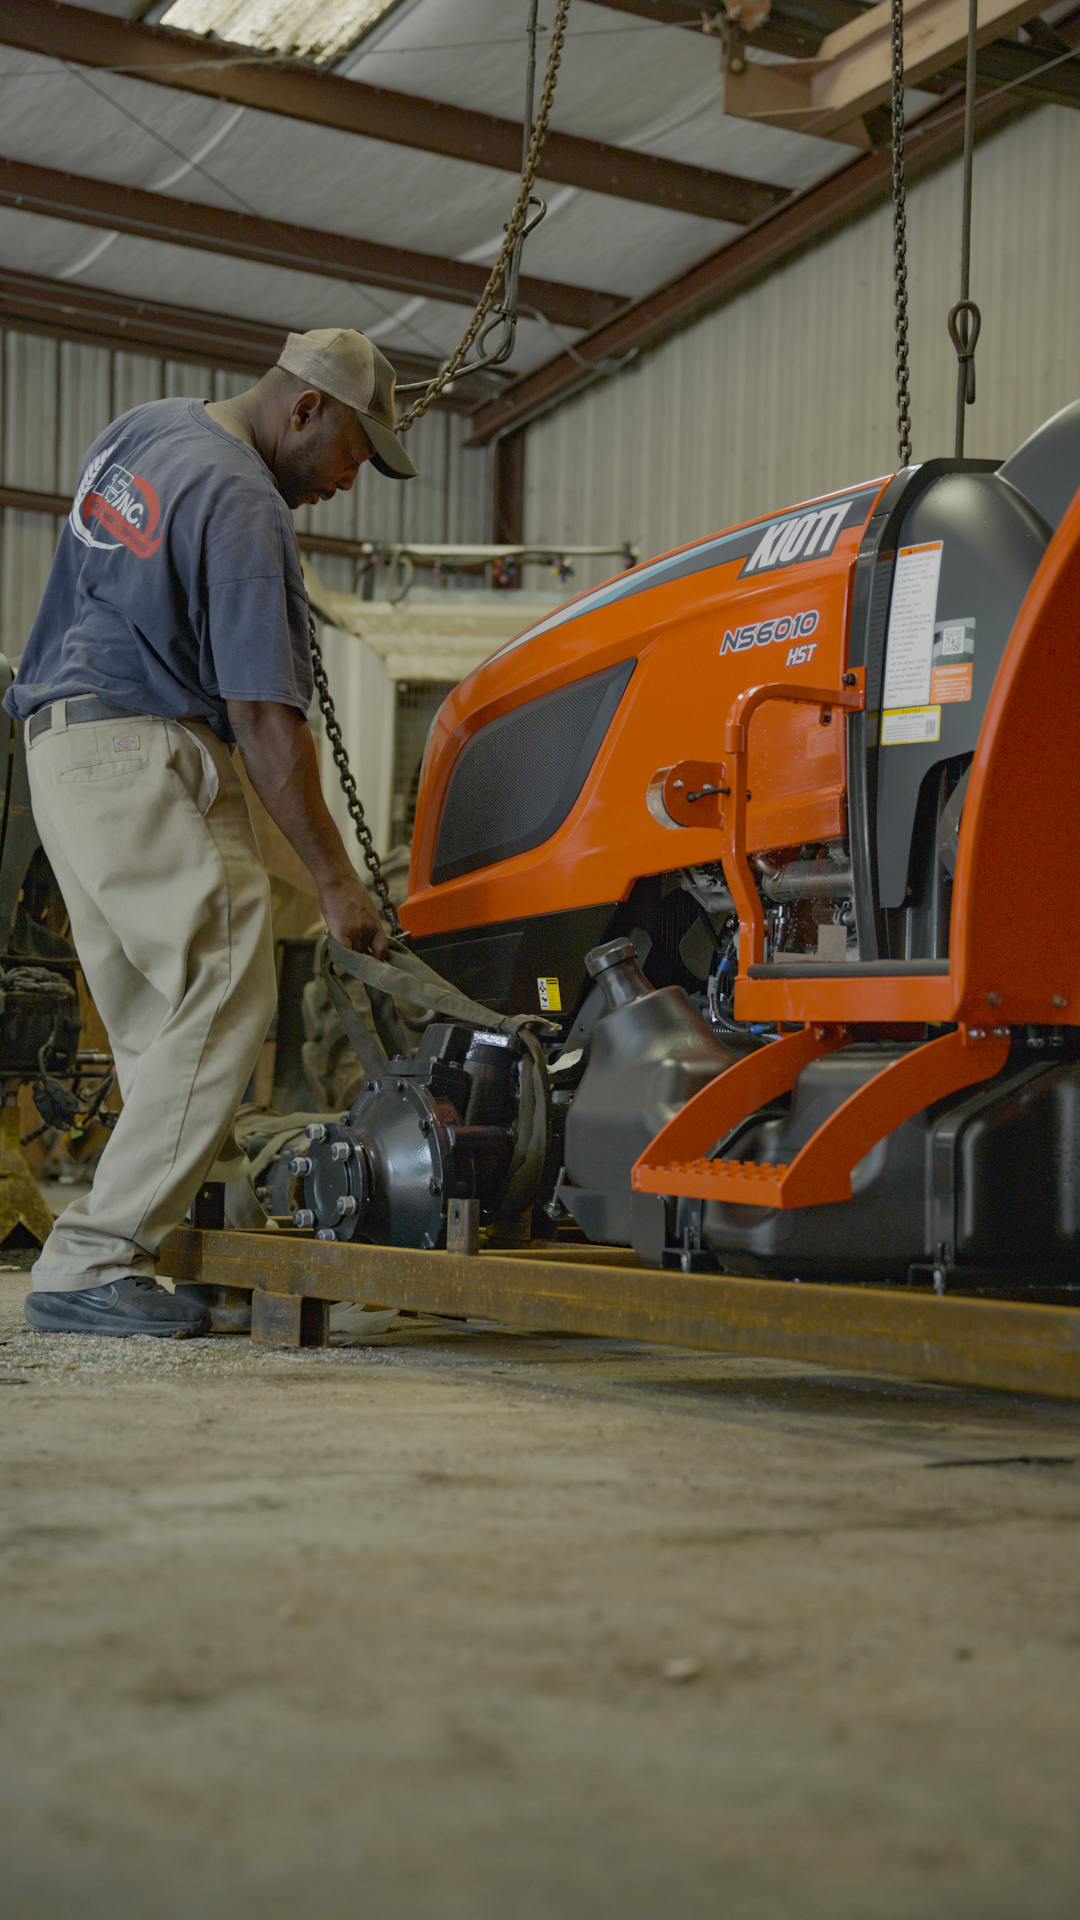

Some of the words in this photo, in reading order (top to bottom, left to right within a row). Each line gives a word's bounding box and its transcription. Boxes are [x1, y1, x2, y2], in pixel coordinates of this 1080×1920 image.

[744, 501, 853, 572] KIOTI
[719, 609, 820, 656] NS6010
[785, 642, 818, 668] HST
